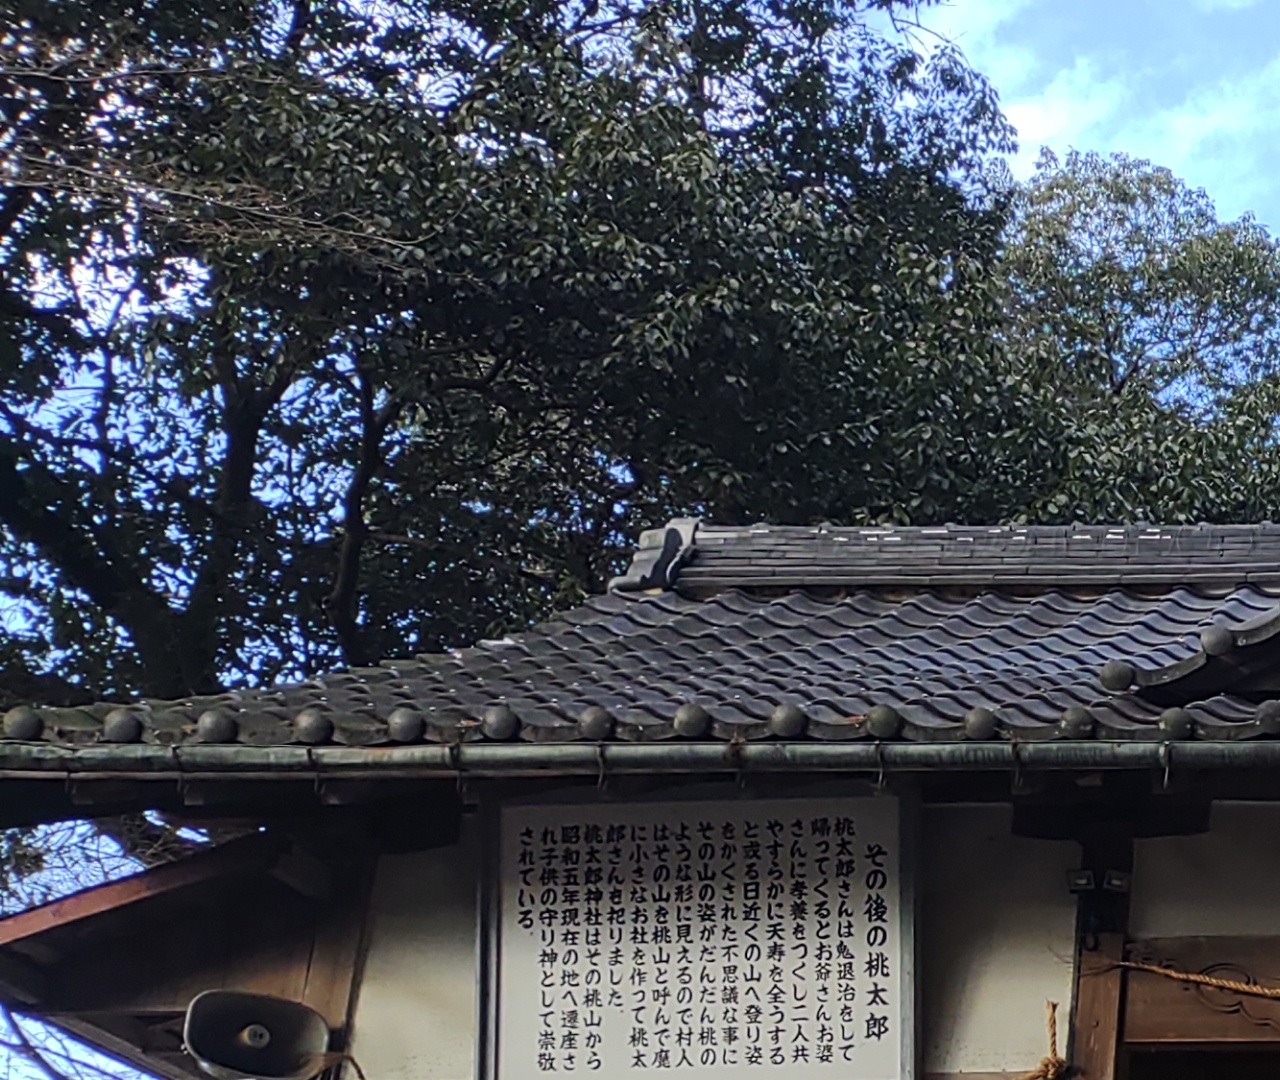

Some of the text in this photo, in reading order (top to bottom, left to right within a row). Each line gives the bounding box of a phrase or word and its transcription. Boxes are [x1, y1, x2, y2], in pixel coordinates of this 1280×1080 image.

[517, 825, 536, 936] されている。
[537, 826, 560, 1072] れ子供の守り神として崇敬
[582, 823, 604, 1071] 桃太郎神社はその桃山から
[628, 824, 650, 1068] に小さなお社を作って桃太
[672, 821, 694, 1068] ような形に見えるので村人
[696, 820, 718, 1066] その山の姿がだんだん桃の
[720, 821, 739, 1065] をかくされた不思議な事に
[741, 820, 763, 1066] と或る日近くの山へ登り姿
[764, 818, 786, 1066] やすらかに天寿を全うする
[810, 817, 834, 1064] 帰ってくるとお爺さんお婆
[834, 815, 856, 1062] 桃太郎さんは鬼退治をして
[863, 843, 890, 1041] その後の桃太郎
